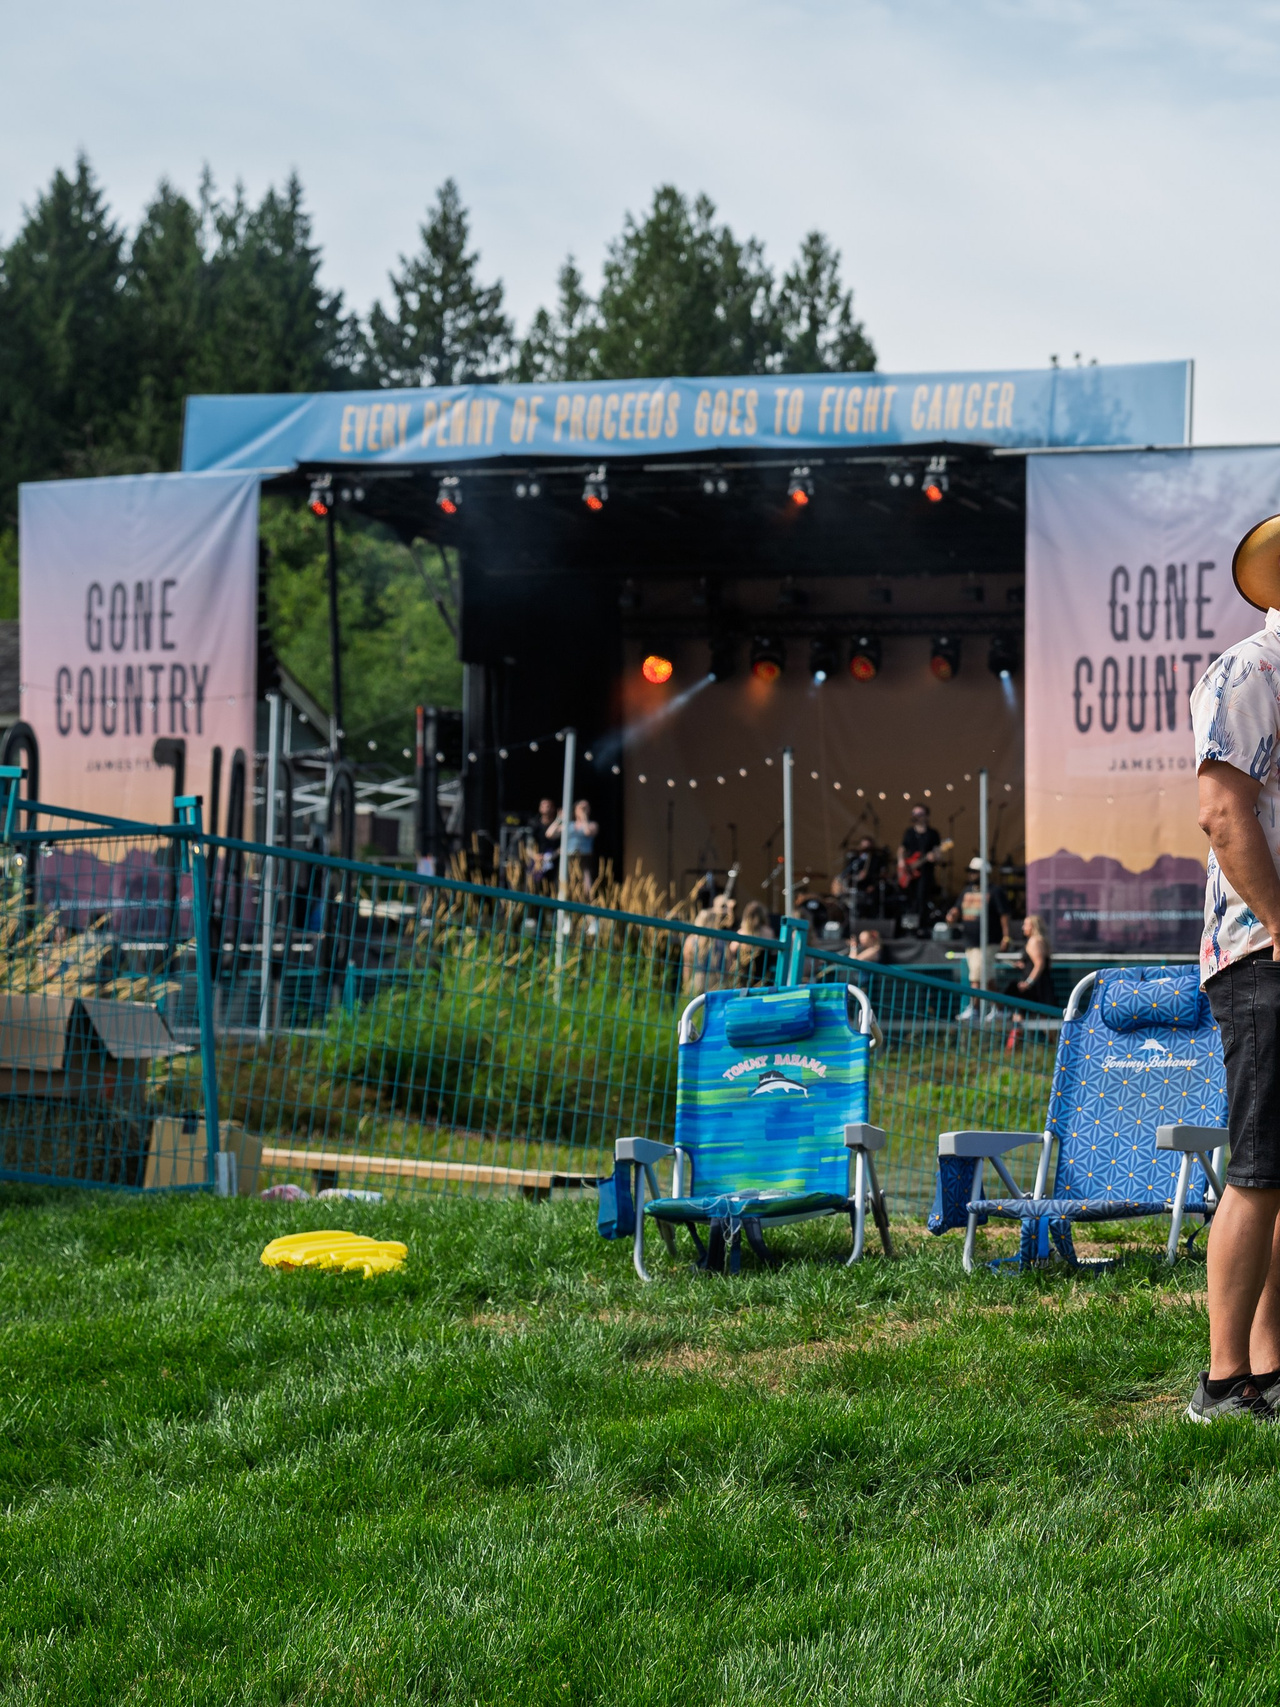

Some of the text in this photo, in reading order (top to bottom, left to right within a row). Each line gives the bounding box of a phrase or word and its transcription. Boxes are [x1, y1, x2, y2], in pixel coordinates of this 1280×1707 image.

[339, 382, 1016, 452] EVERY PENNY OF PROCEEDS GOES TO FIGHT CANCER
[86, 579, 178, 652] GONE
[1109, 561, 1217, 642] GONE
[54, 662, 210, 737] COUNTRY
[1073, 653, 1221, 734] COUNT
[1108, 757, 1196, 772] JAMESTO
[722, 1054, 826, 1081] TOMMY BAHAMA
[1101, 1054, 1197, 1073] Tommy Bahama
